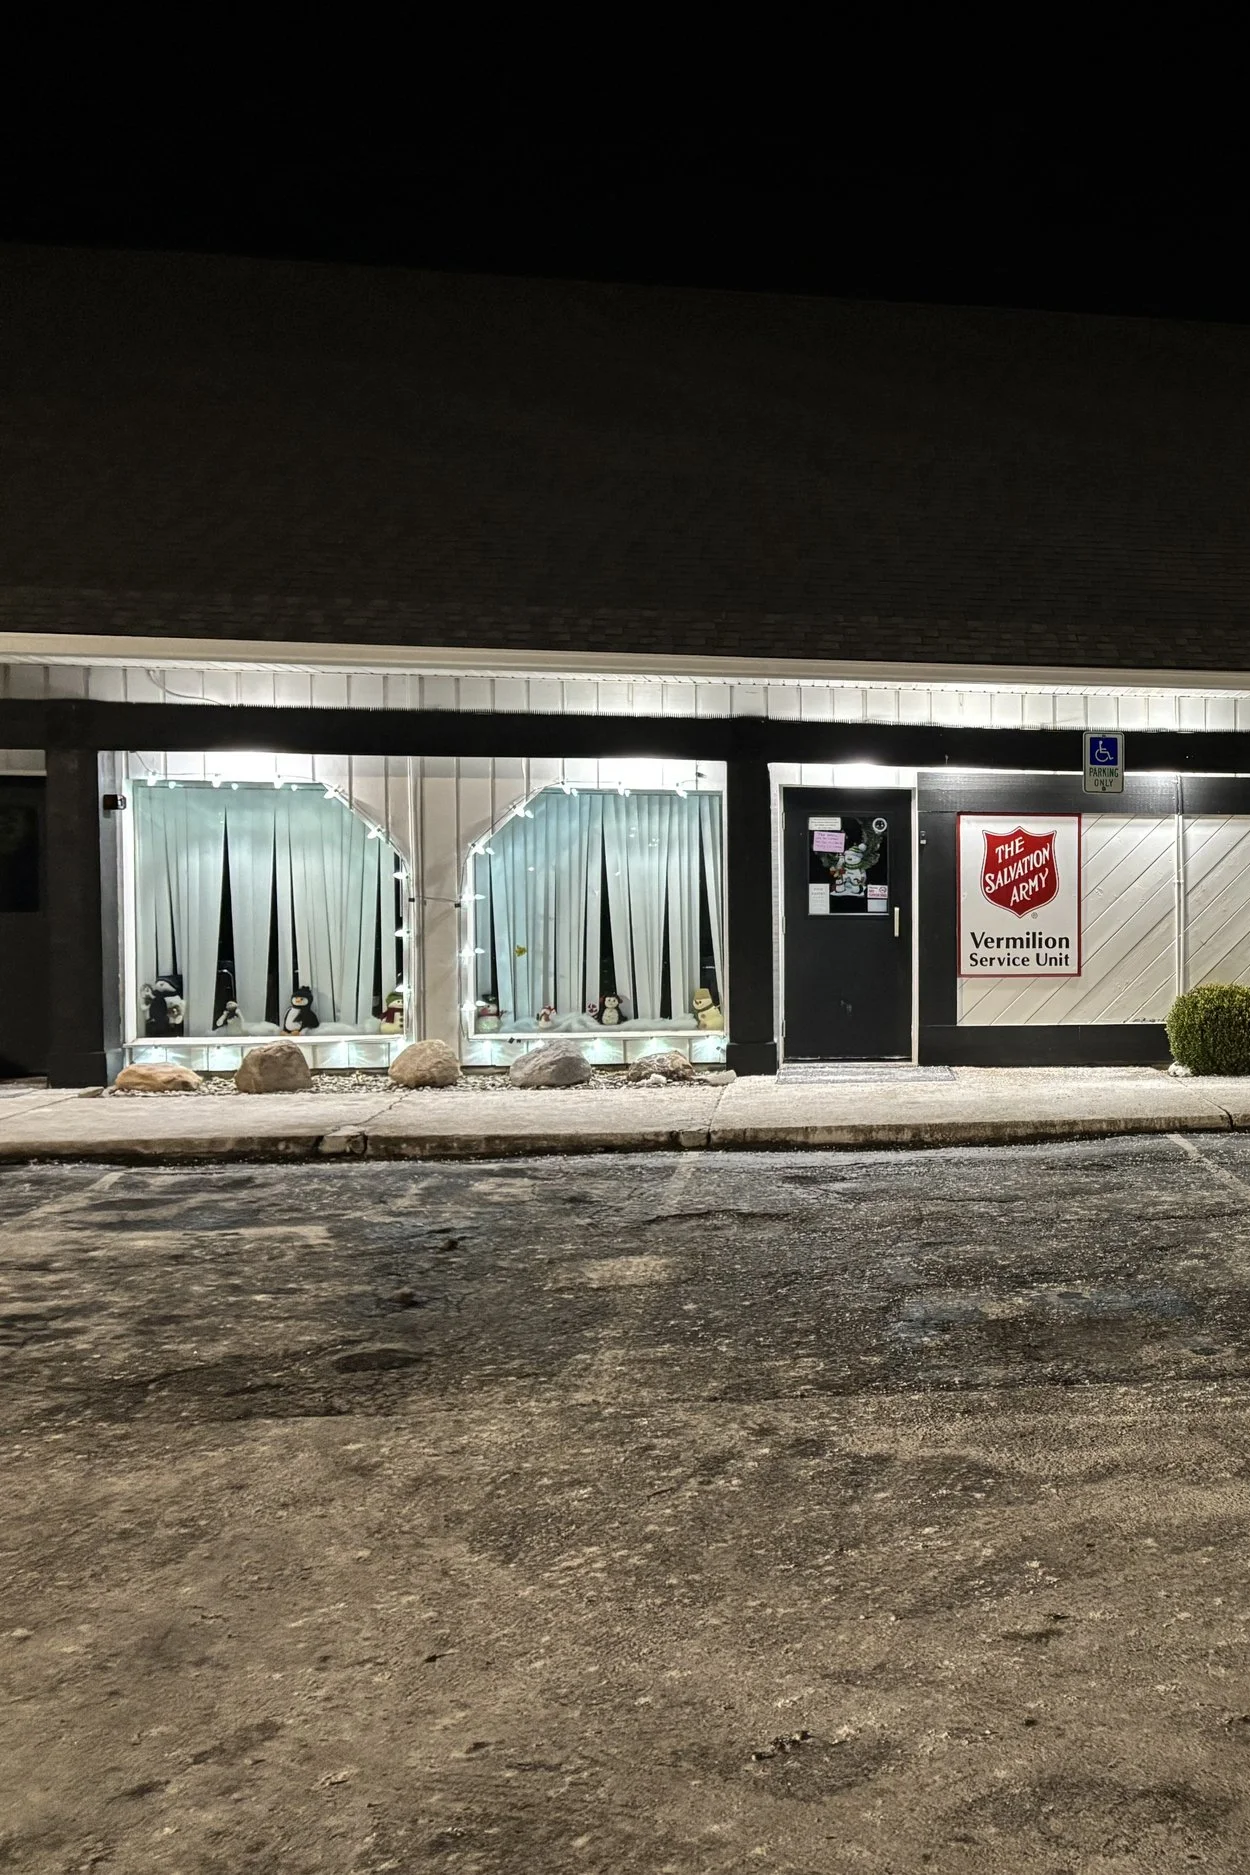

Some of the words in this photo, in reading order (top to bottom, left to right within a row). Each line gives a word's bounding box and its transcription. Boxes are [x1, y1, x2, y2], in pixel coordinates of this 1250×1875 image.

[1089, 767, 1119, 778] PARKING
[1094, 779, 1113, 787] ONLY
[995, 836, 1025, 864] THE
[985, 843, 1050, 894] SALVATION
[1010, 867, 1049, 907] ARMY
[970, 931, 1070, 949] Vermilion
[969, 952, 1030, 967] Service
[1036, 952, 1070, 967] Unit
